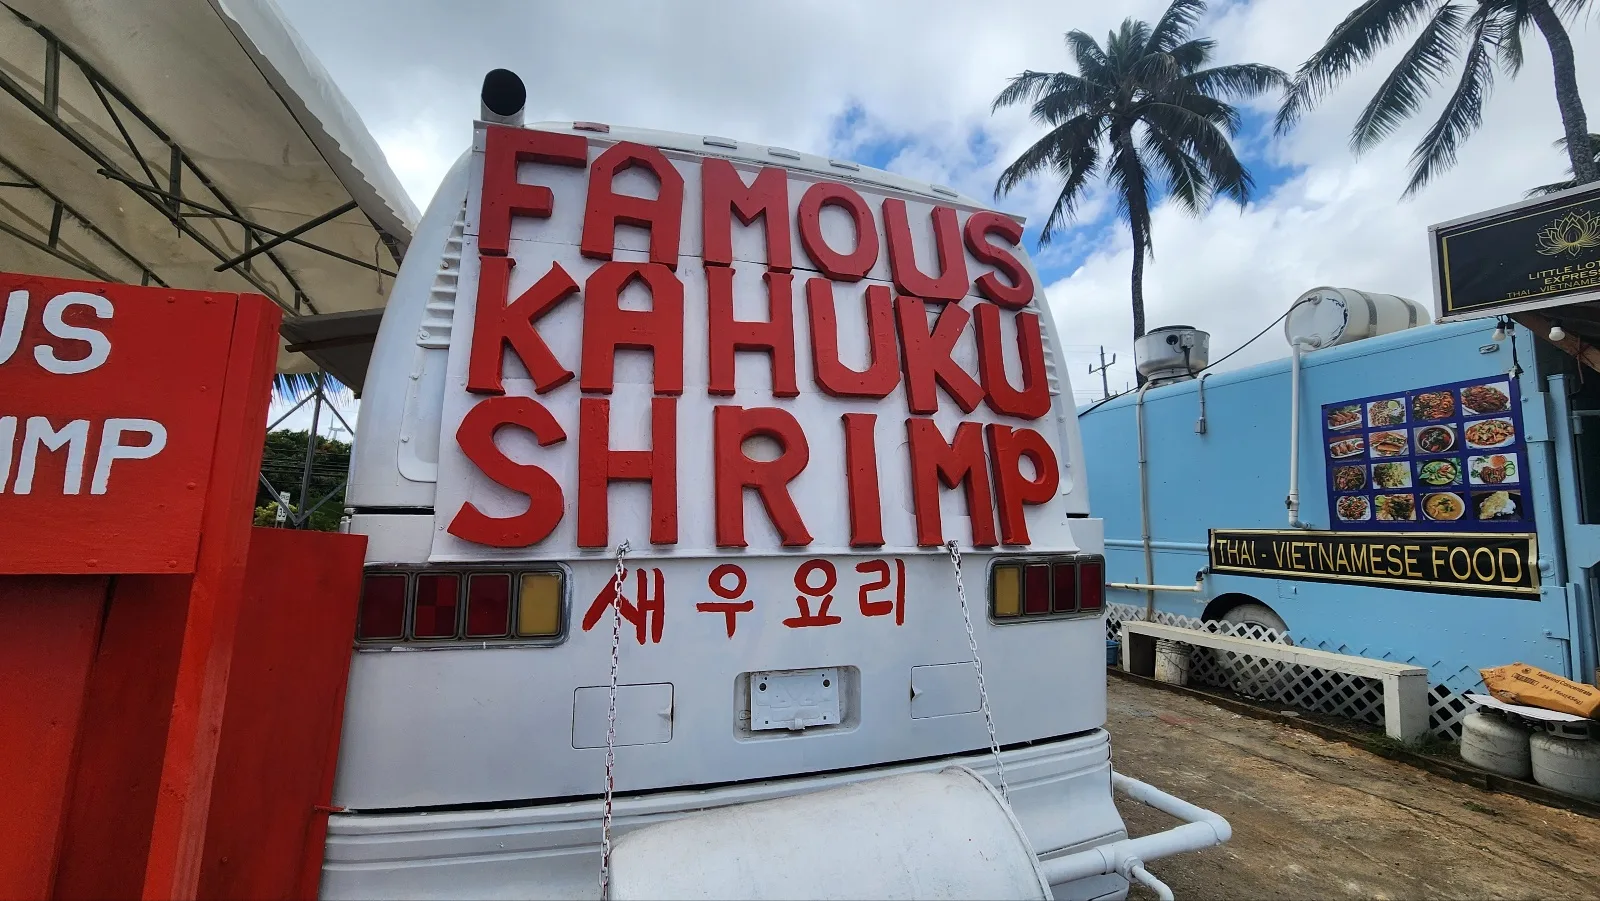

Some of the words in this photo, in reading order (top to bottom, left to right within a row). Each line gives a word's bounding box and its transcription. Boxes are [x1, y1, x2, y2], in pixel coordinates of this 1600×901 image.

[478, 124, 1034, 311] FAMOUS
[1528, 265, 1573, 280] LITTLE
[1544, 269, 1600, 285] EXPRES
[1507, 289, 1531, 299] THAI
[465, 256, 1052, 421] KAHUKU
[447, 395, 1061, 548] SHRIMP
[1216, 539, 1258, 566] THAI
[1272, 541, 1424, 578] VIETNAMESE
[1431, 546, 1523, 583] FOOD
[1560, 680, 1593, 697] Concentrate
